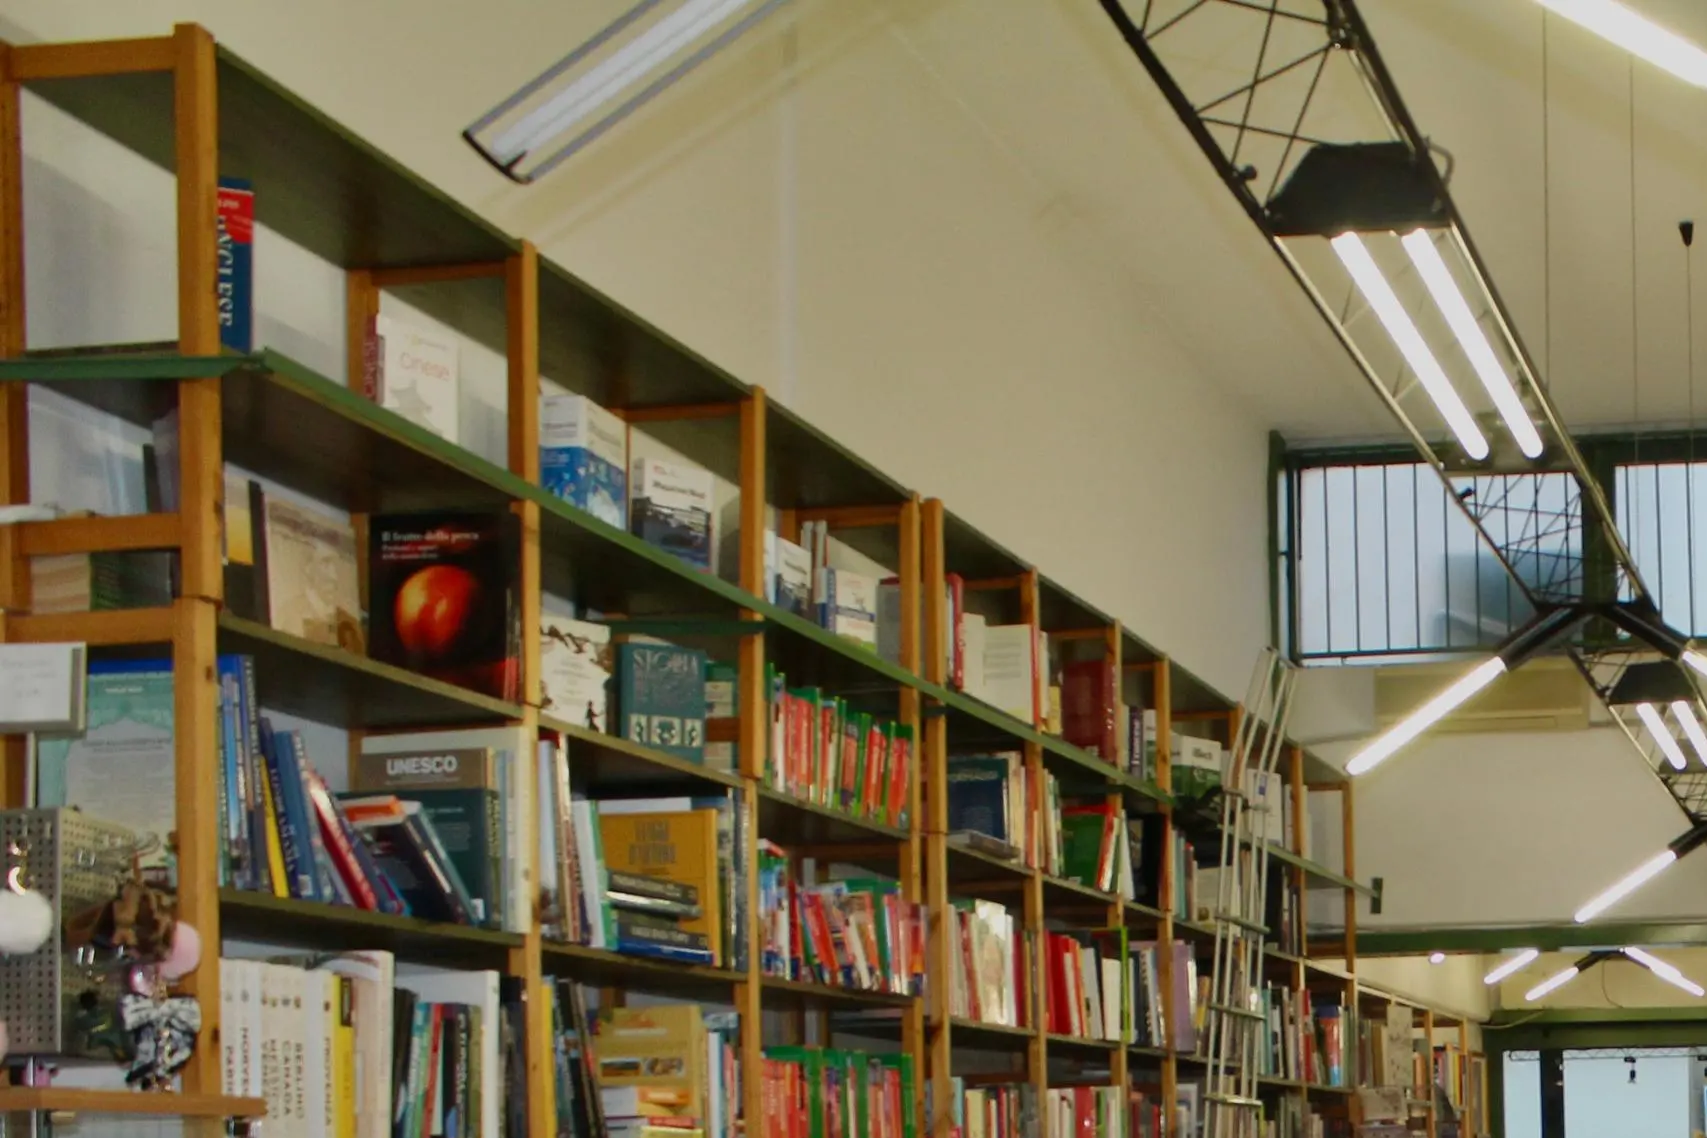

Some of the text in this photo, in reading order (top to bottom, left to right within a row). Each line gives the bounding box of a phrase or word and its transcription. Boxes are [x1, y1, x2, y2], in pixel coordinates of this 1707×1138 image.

[386, 755, 458, 776] UNESCO
[281, 1040, 293, 1116] CANADA
[294, 1042, 306, 1120] BERLINO
